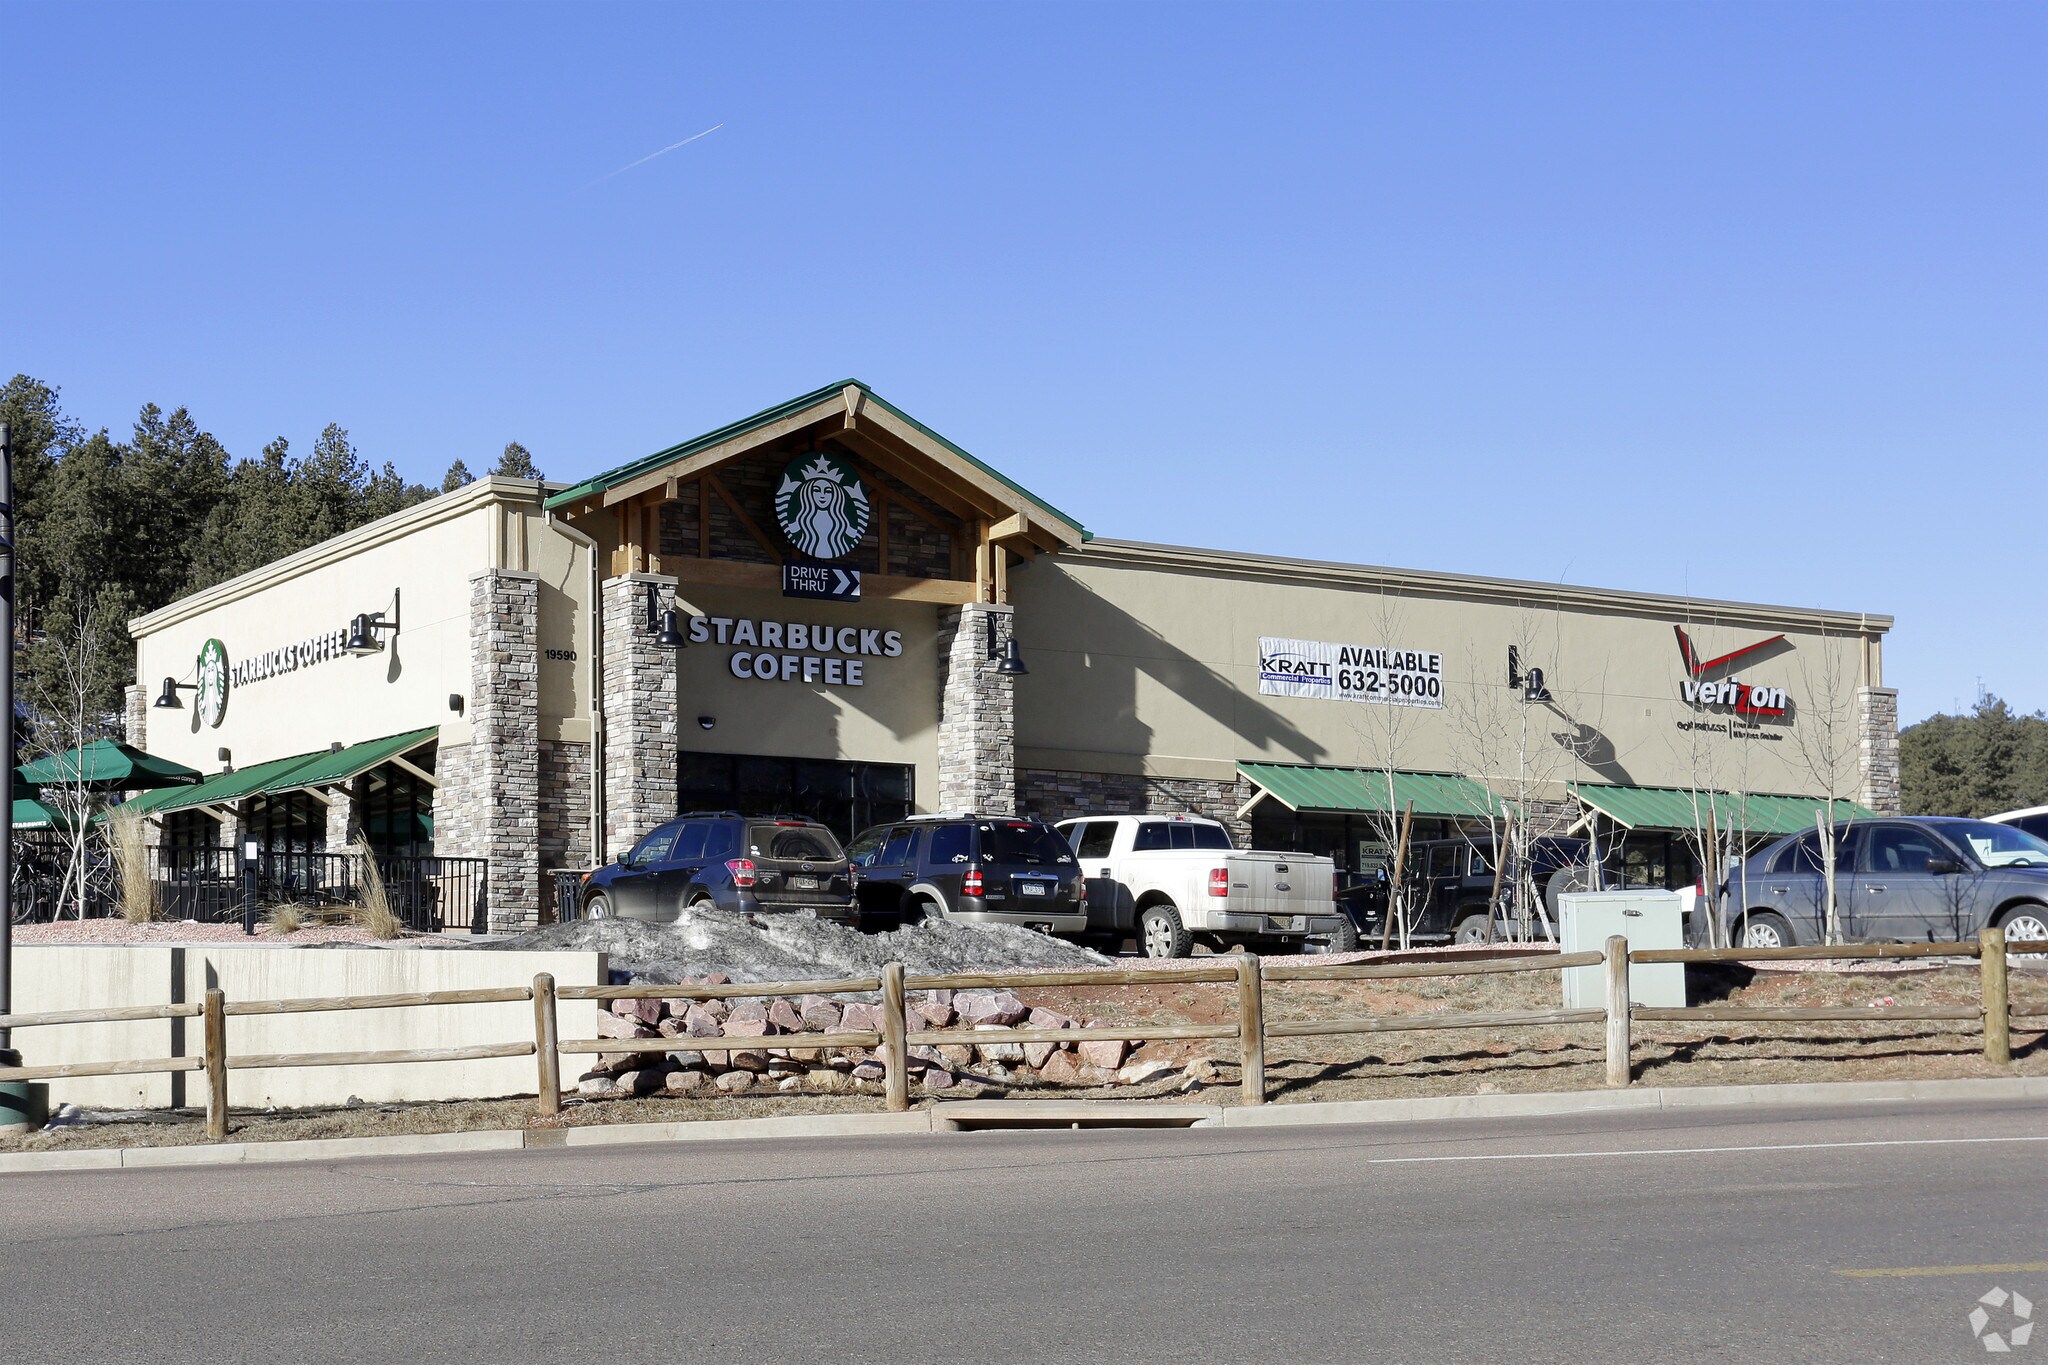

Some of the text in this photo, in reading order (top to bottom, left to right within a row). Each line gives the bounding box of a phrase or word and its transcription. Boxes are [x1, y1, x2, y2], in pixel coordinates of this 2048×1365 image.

[791, 565, 829, 580] DRIVE
[791, 578, 826, 592] THRU
[689, 615, 904, 658] STARBUCKS
[229, 644, 299, 688] STARBUCKS
[296, 627, 346, 667] COFFEE
[544, 649, 577, 661] 19590
[730, 651, 865, 686] COFFEE
[1261, 658, 1331, 677] KRATT
[1338, 646, 1440, 674] AVAILABLE
[1262, 672, 1331, 685] Commercial Properties
[1338, 669, 1440, 698] 632-5000
[1681, 675, 1786, 716] verizon
